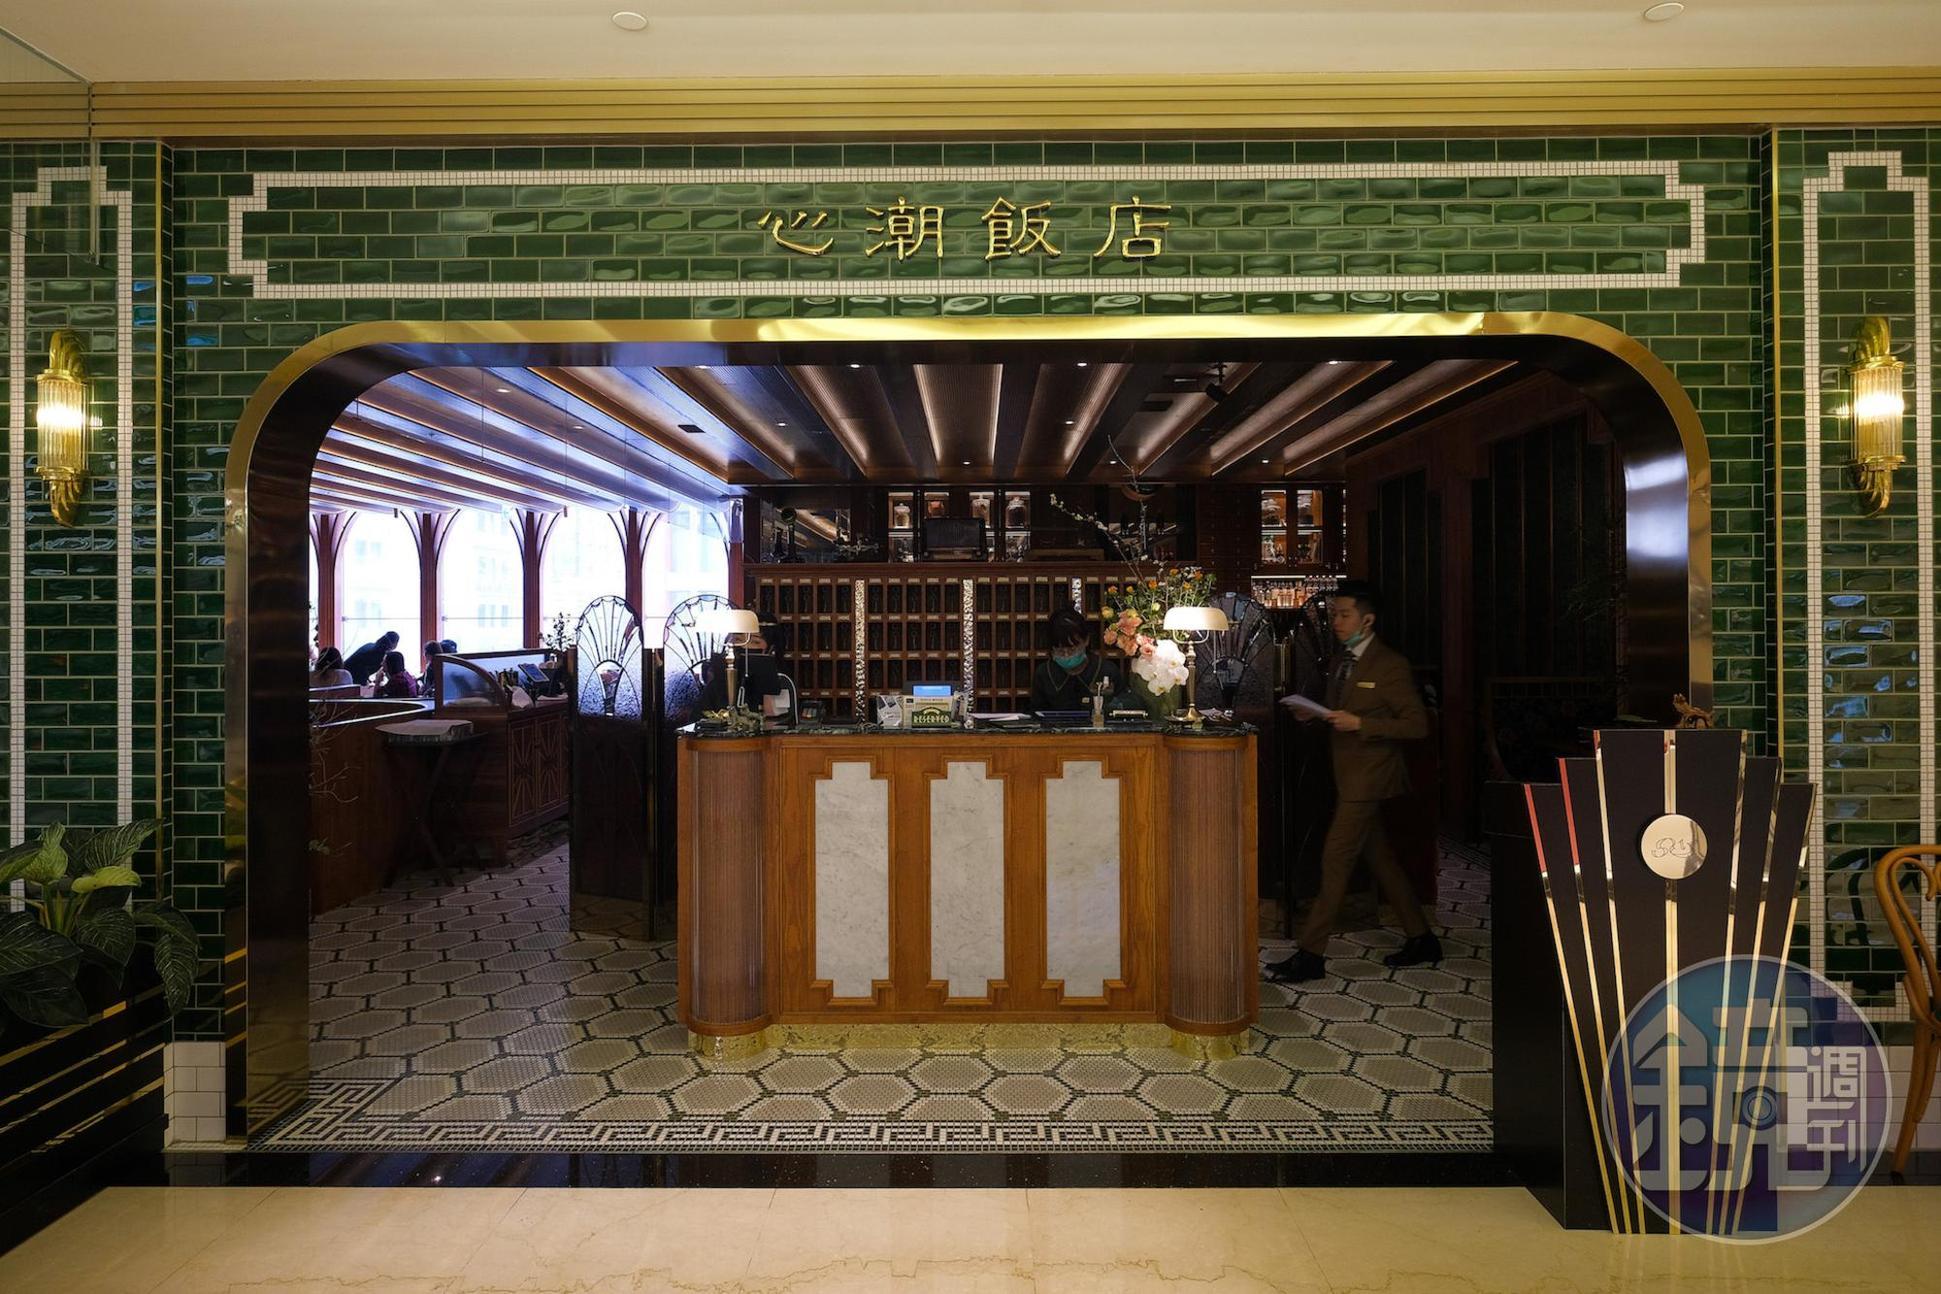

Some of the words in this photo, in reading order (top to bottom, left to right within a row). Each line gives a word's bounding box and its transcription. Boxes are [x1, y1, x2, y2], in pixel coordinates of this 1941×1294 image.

[757, 196, 1172, 261] 心潮飯店
[913, 715, 950, 724] RESERVED
